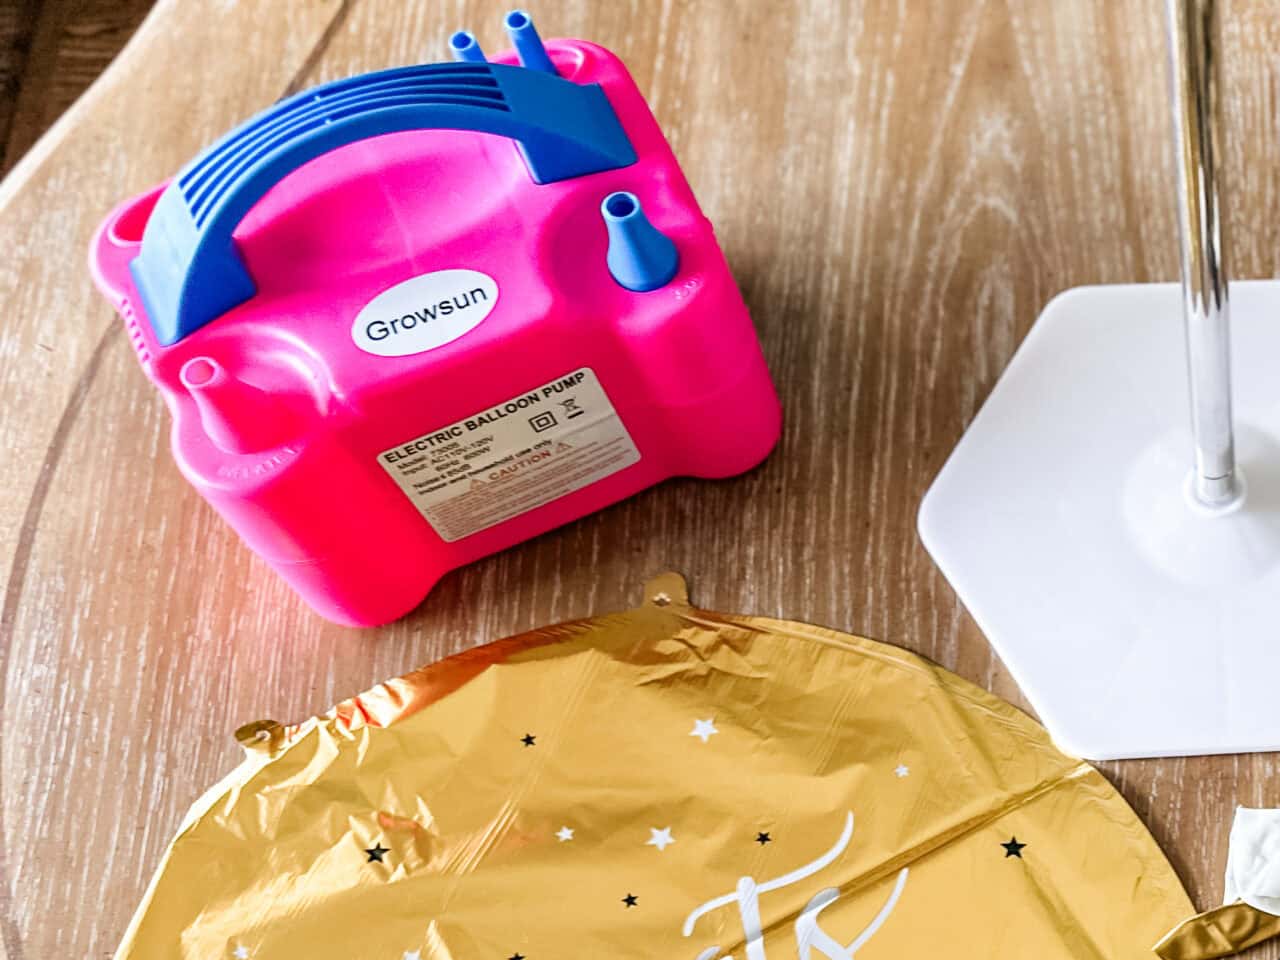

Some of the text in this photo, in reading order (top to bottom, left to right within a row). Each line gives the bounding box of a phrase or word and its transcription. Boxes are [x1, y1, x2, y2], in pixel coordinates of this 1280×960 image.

[366, 286, 489, 342] Growsun
[383, 371, 586, 464] ELECTRIC BALLOON PUMP
[488, 449, 552, 481] CAUTION
